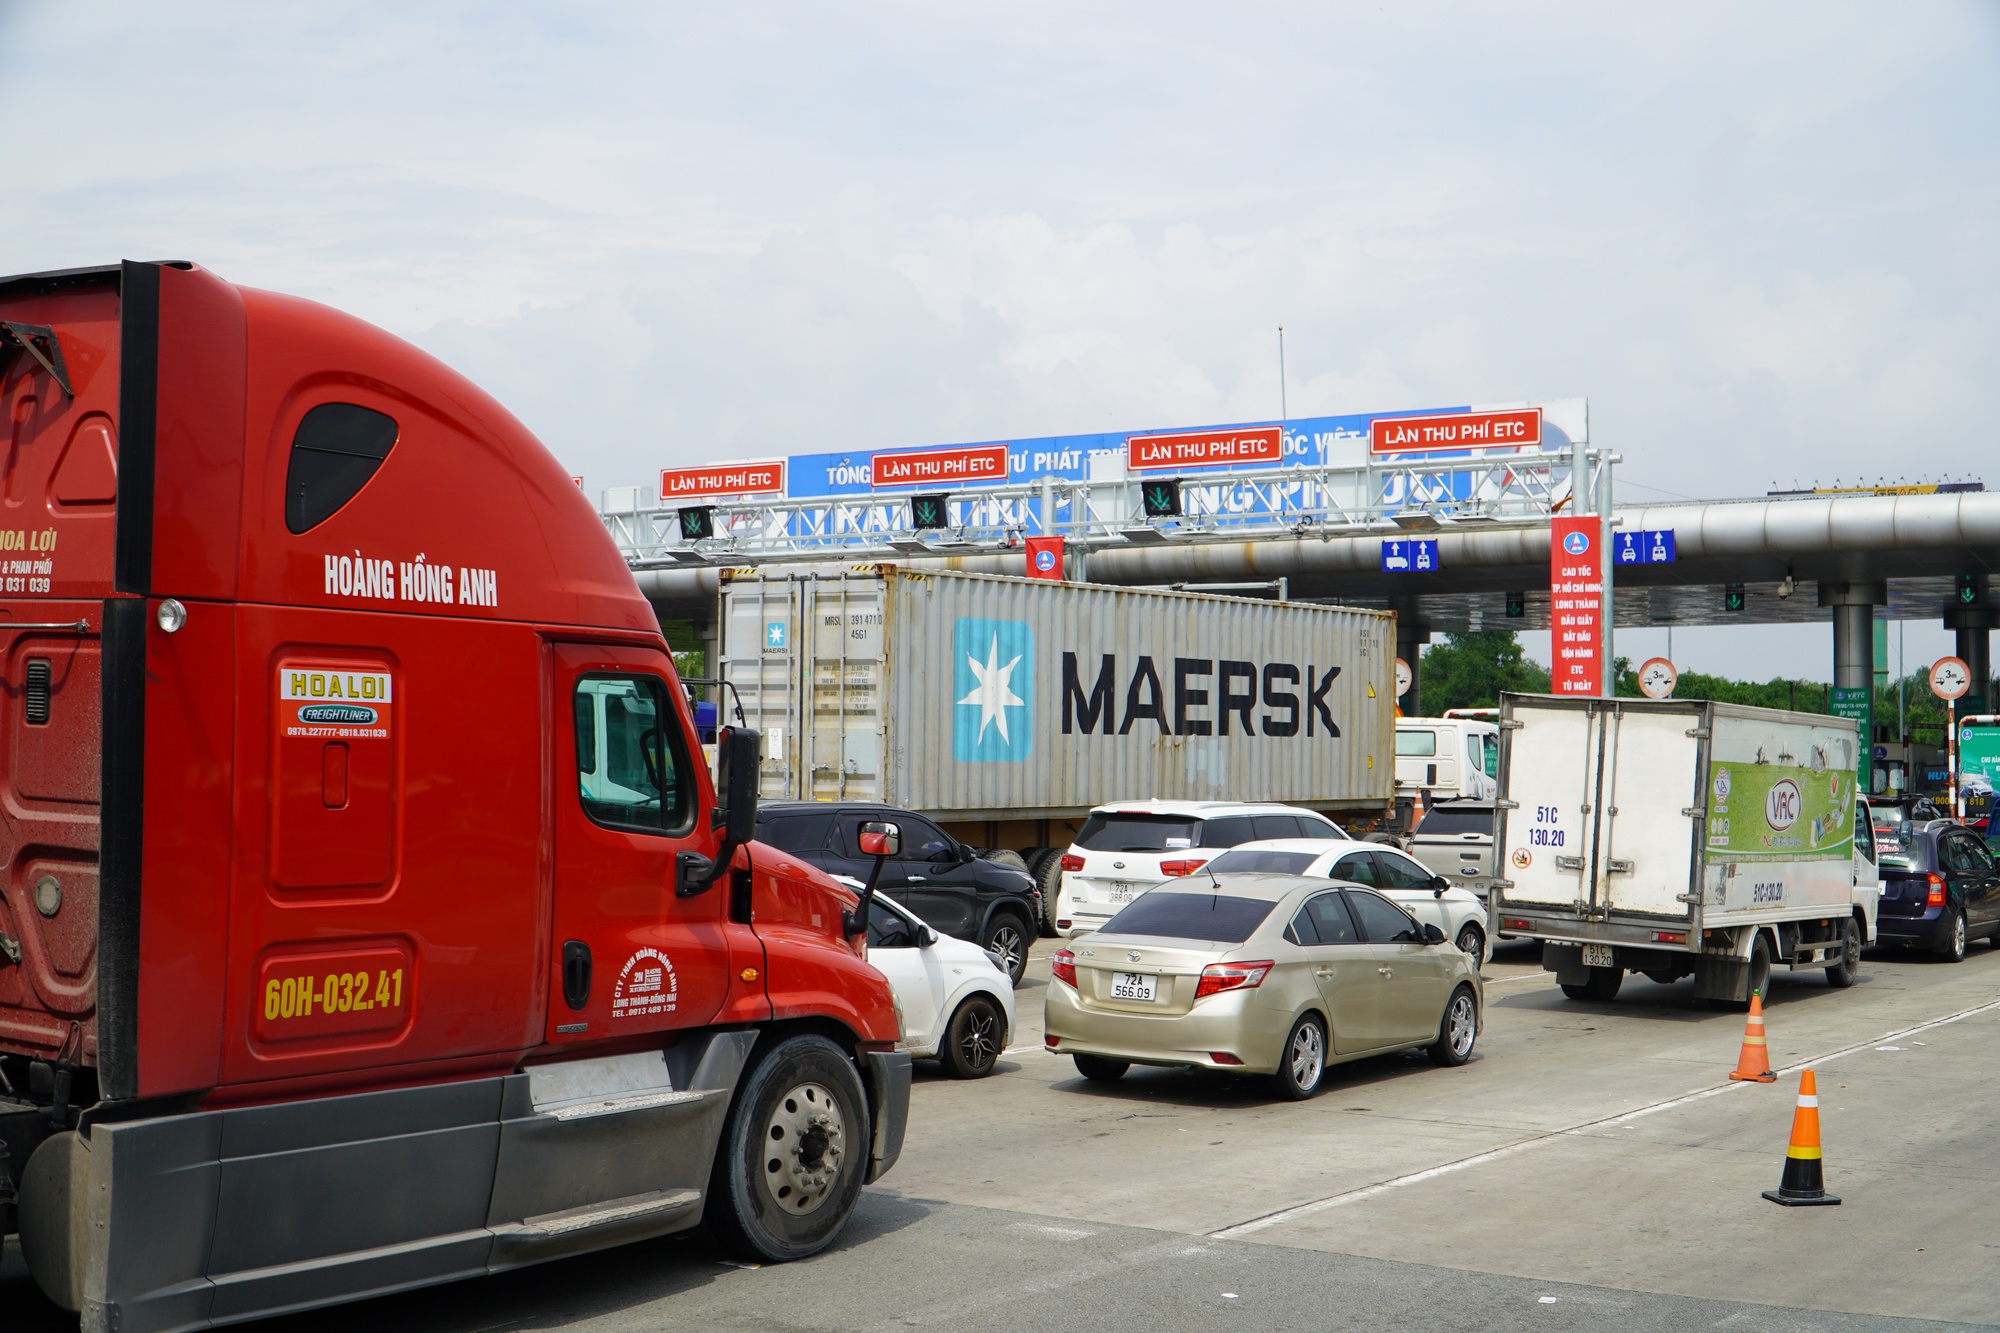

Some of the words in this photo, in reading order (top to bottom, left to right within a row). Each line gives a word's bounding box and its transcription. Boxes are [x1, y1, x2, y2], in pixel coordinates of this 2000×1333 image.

[1385, 426, 1419, 444] LÀN
[1423, 426, 1456, 442] THU
[1462, 421, 1489, 439] PHÍ
[1494, 421, 1525, 437] ETC
[1141, 443, 1171, 460] LÀN
[1176, 443, 1206, 458] THU
[1210, 438, 1237, 456] PHÍ
[1240, 439, 1268, 454] ETC
[826, 458, 871, 485] TỔNG
[1034, 446, 1082, 472] PHÁT
[883, 461, 911, 477] LÀN
[914, 461, 940, 475] THU
[944, 456, 968, 473] PHÍ
[970, 457, 995, 472] ETC
[671, 475, 695, 491] LÀN
[698, 476, 722, 489] THU
[725, 471, 747, 487] PHÍ
[749, 473, 771, 486] ETC
[30, 527, 57, 557] LỢI
[325, 549, 395, 599] HOÀNG
[400, 553, 454, 604] HỒNG
[459, 568, 498, 607] ANH
[1562, 568, 1576, 577] CAO
[1577, 565, 1592, 577] TỐC
[6, 577, 25, 592] 031
[29, 578, 51, 593] 039
[1573, 581, 1584, 593] CHÍ
[1585, 583, 1601, 593] MINH
[1555, 600, 1573, 609] LONG
[1575, 597, 1598, 609] THÀNH
[851, 615, 863, 625] 391
[1575, 646, 1593, 659] HÀNH
[1571, 665, 1584, 674] ETC
[1573, 680, 1592, 691] NGÀY
[1062, 651, 1342, 738] MAERSK
[305, 708, 371, 721] FREIGHTLINER
[1772, 791, 1795, 820] VAC
[1537, 806, 1558, 823] 51C
[1529, 828, 1565, 847] 130.20
[1590, 945, 1606, 955] 51C
[1125, 974, 1143, 986] 72A
[265, 968, 402, 1021] 60H-032.41
[1115, 985, 1151, 998] 566.09
[613, 998, 629, 1008] LONG
[666, 993, 677, 1002] NAI
[663, 1004, 676, 1012] 139
